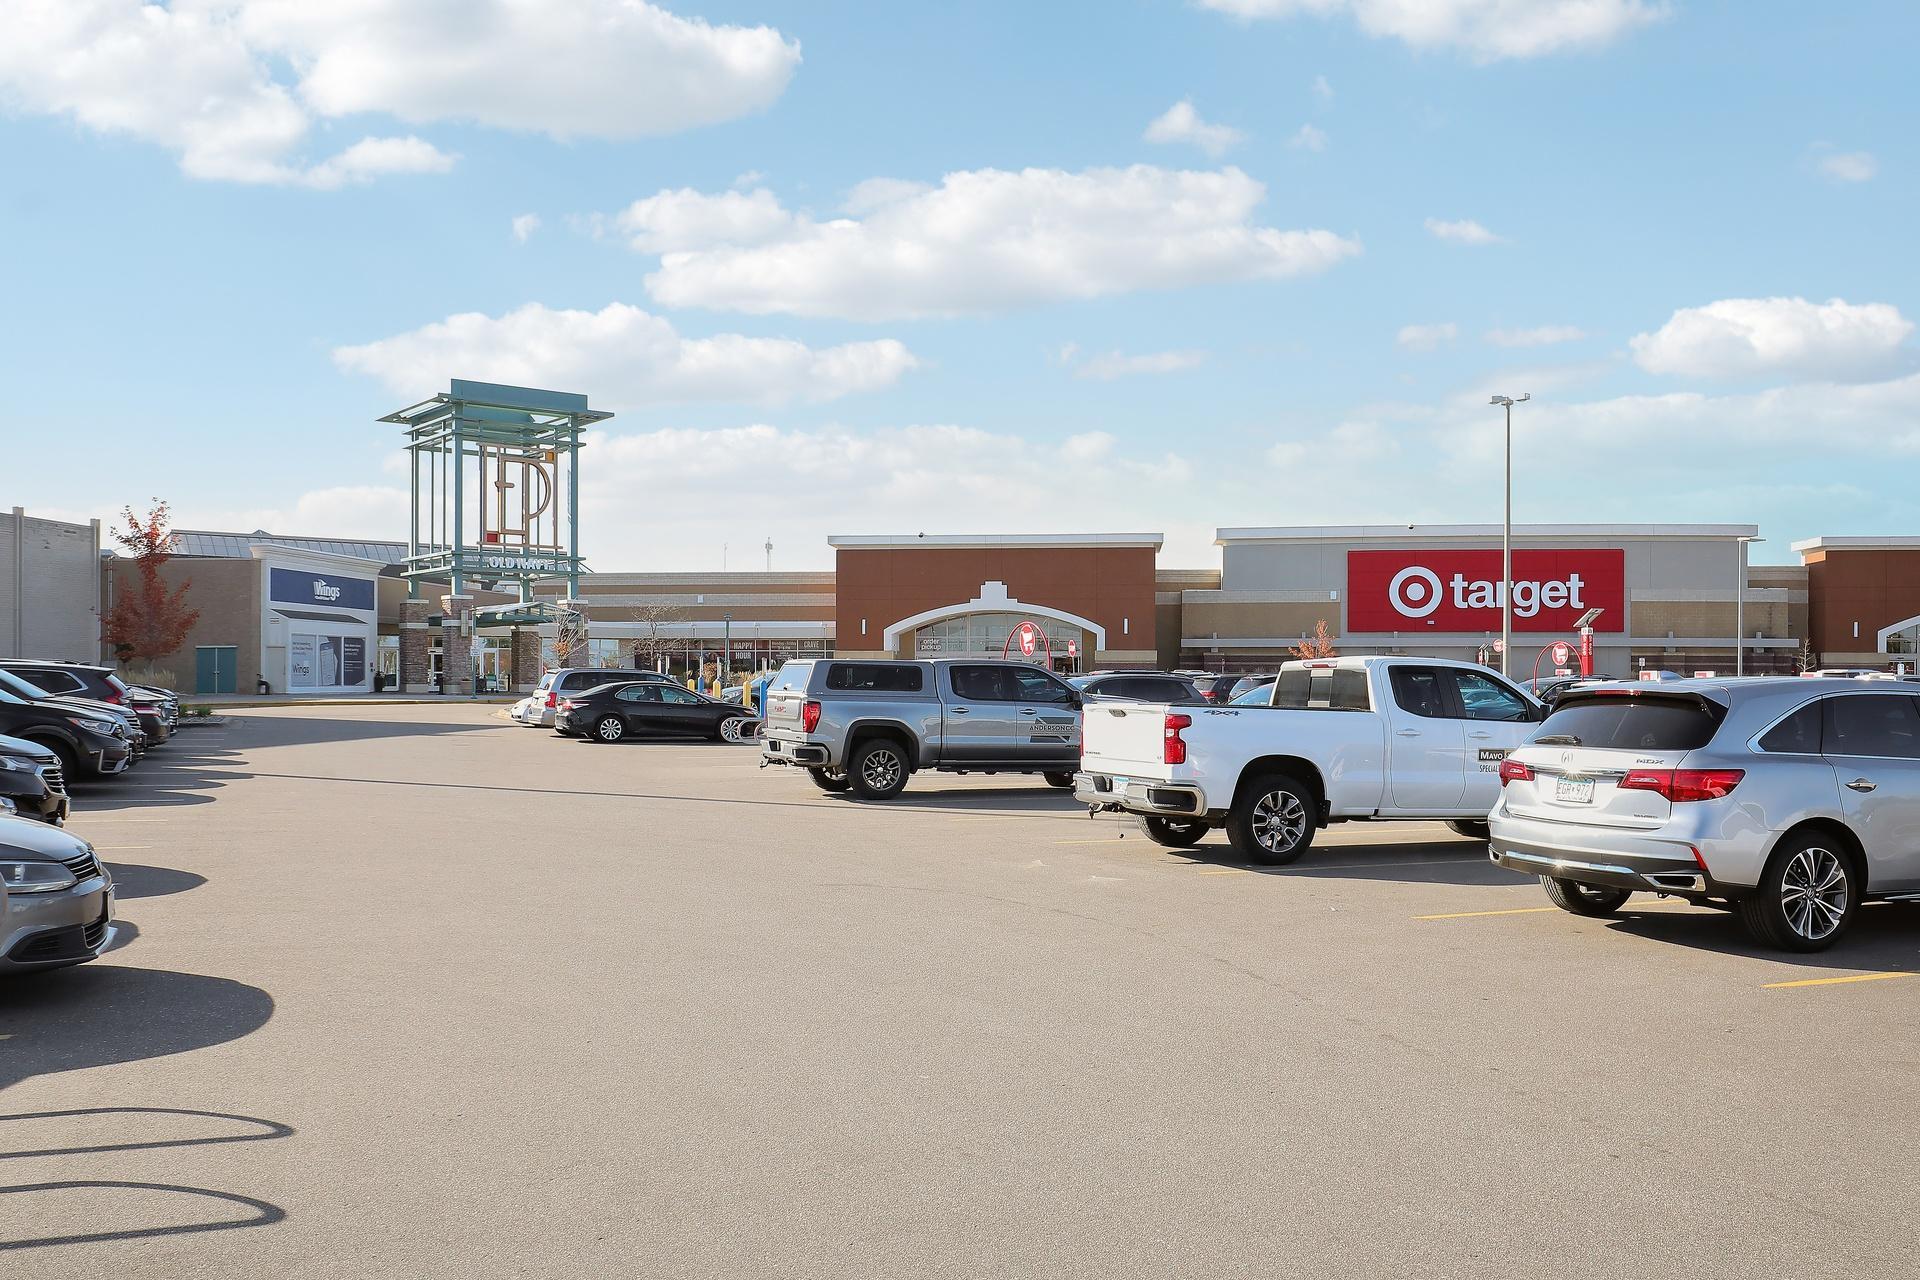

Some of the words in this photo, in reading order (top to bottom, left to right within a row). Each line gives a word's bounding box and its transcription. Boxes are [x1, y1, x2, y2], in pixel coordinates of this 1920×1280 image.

[489, 556, 515, 569] OLD
[517, 558, 550, 571] NAVY
[313, 579, 341, 601] Wings
[1449, 573, 1585, 618] target
[733, 642, 753, 650] HAPPY
[803, 641, 820, 649] CRAVE
[920, 643, 942, 651] pickup
